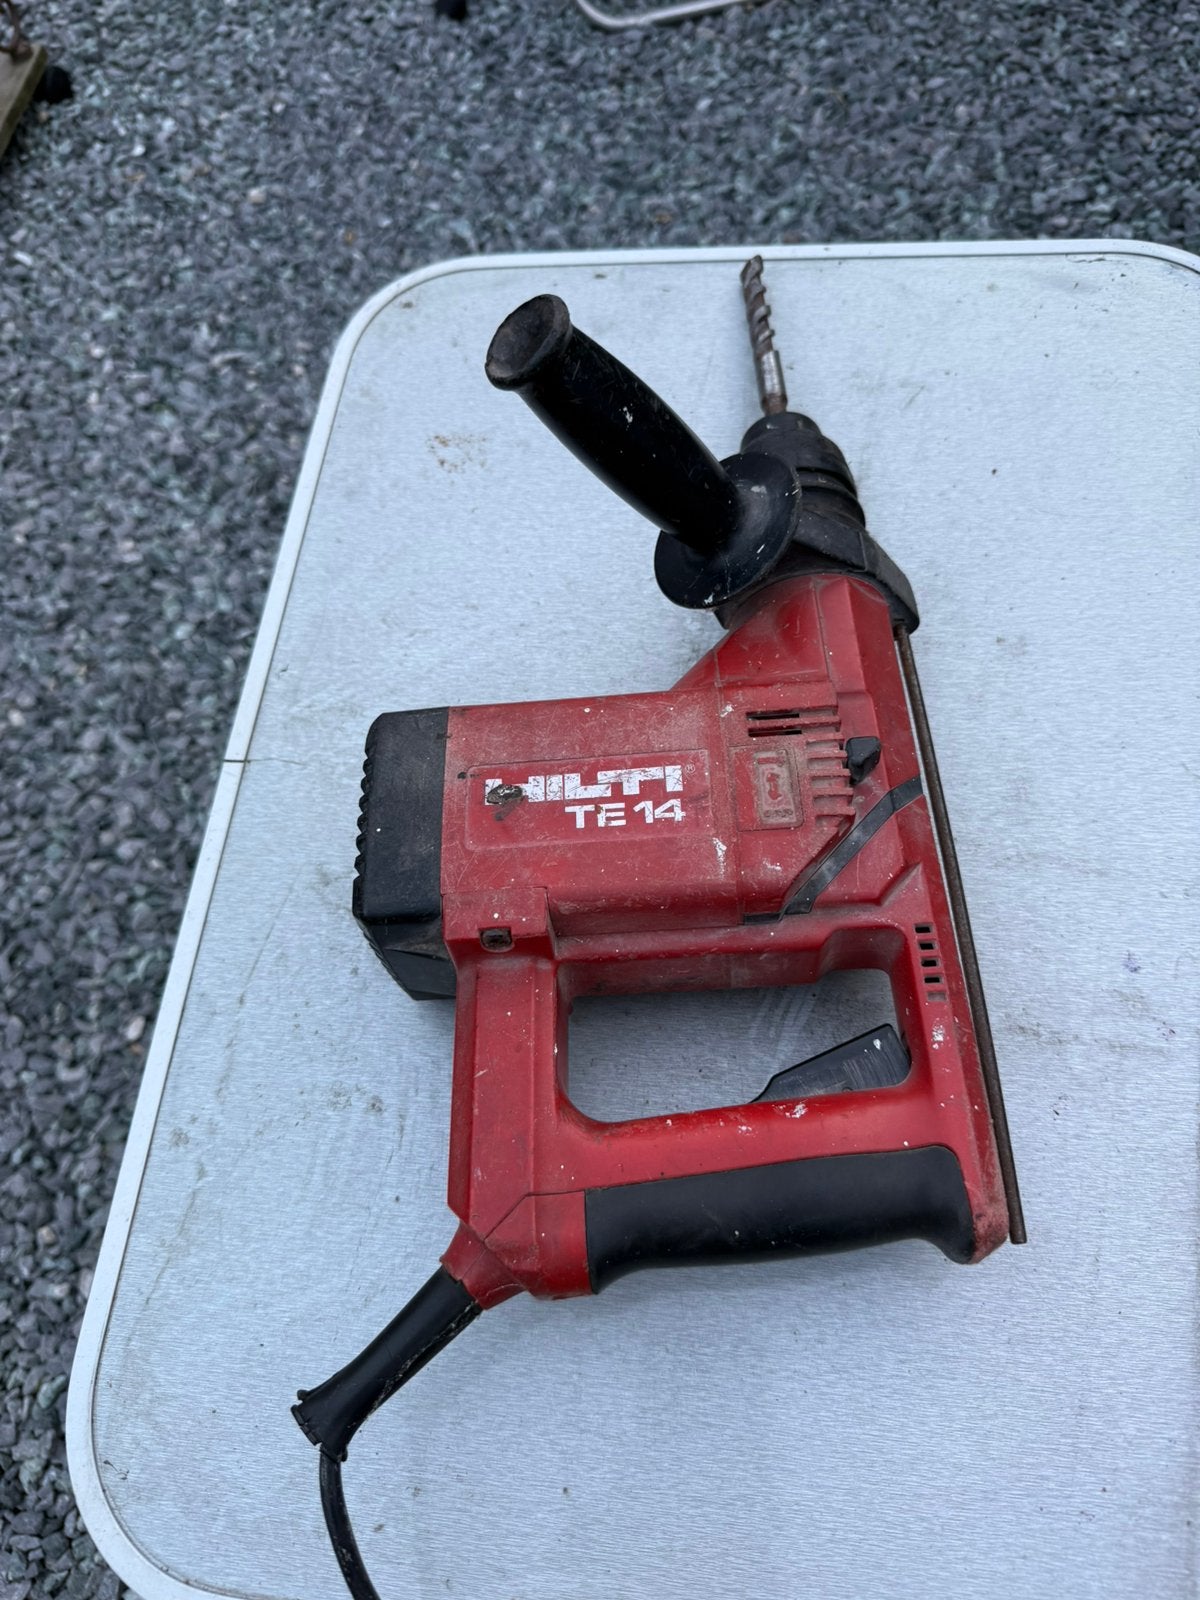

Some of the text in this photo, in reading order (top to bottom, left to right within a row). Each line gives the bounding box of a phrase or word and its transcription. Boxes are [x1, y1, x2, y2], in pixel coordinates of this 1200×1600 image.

[485, 765, 683, 805] HILTI
[564, 799, 685, 828] TE 14
